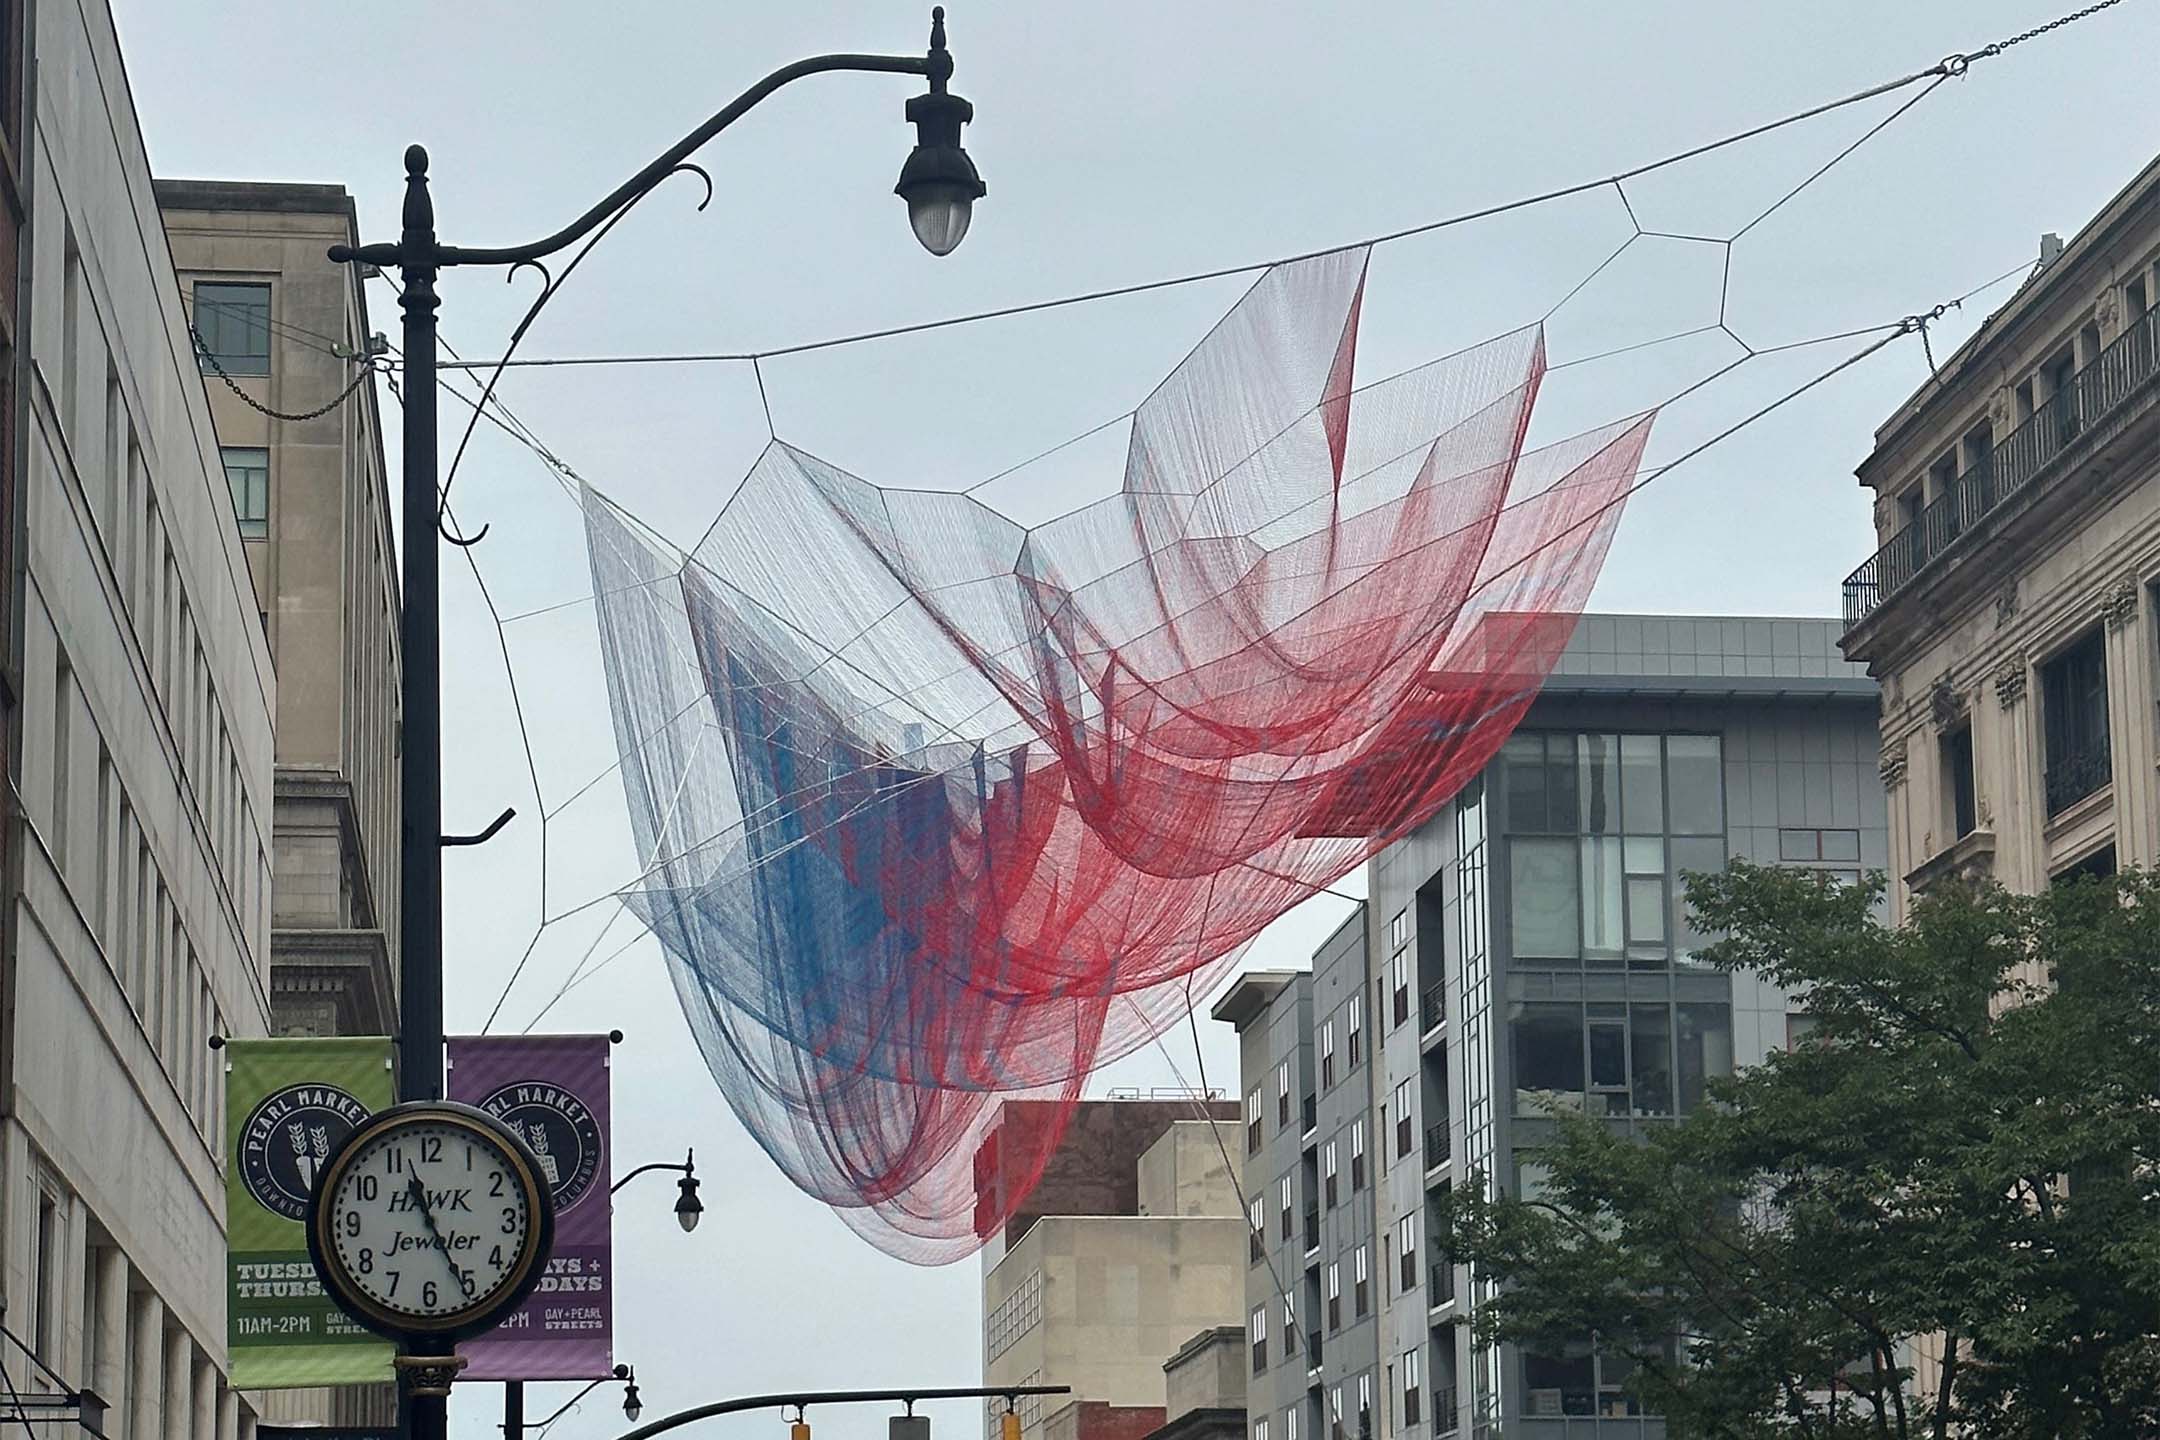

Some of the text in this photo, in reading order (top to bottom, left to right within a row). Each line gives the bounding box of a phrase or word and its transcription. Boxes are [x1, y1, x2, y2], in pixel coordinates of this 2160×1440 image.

[518, 1087, 589, 1125] MARKET
[248, 1100, 292, 1151] PEARL
[386, 1148, 402, 1174] 11
[421, 1137, 443, 1163] 12
[466, 1144, 473, 1171] 1
[256, 1177, 304, 1217] DOWNTO
[356, 1175, 378, 1201] 10
[488, 1171, 504, 1197] 2
[388, 1189, 472, 1212] HAWK
[346, 1211, 361, 1237] 9
[501, 1208, 516, 1234] 3
[382, 1230, 480, 1257] Jeweler
[358, 1248, 373, 1274] 8
[488, 1245, 504, 1270] 4
[544, 1258, 581, 1274] AYS
[237, 1263, 317, 1279] TUESD
[386, 1271, 400, 1297] 7
[461, 1270, 475, 1296] 5
[534, 1276, 602, 1292] DAYS
[237, 1281, 328, 1298] THURS
[422, 1281, 437, 1308] 6
[237, 1316, 311, 1334] 11AM-2PM
[545, 1321, 603, 1330] STREETS
